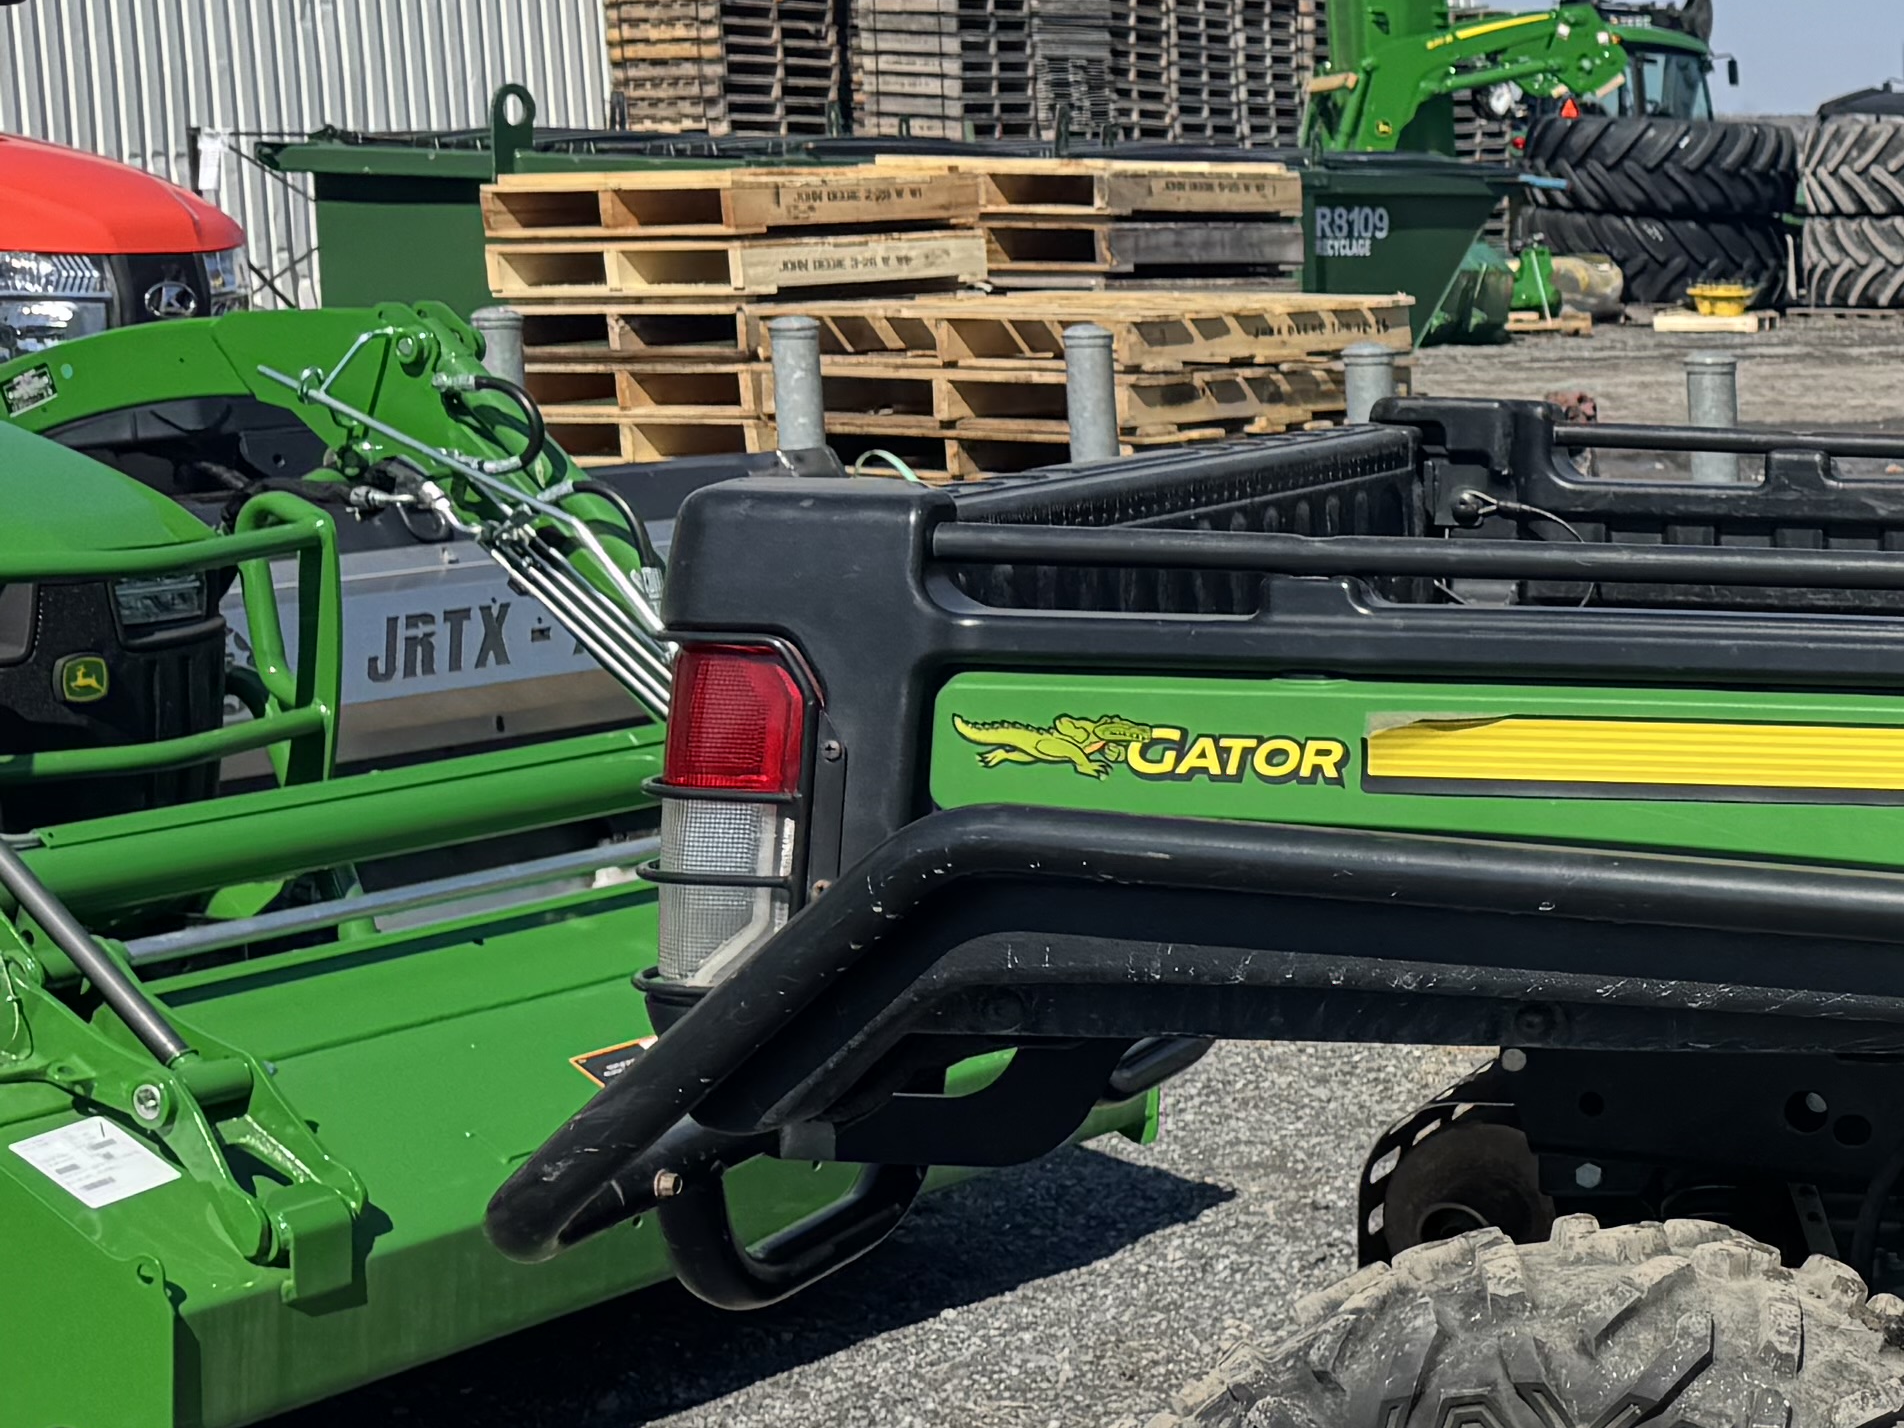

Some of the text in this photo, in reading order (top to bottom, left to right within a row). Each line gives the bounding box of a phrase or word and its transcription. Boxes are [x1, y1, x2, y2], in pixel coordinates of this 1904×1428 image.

[1315, 206, 1390, 239] R8109
[367, 602, 511, 683] JRTX
[1127, 727, 1346, 783] GATOR
